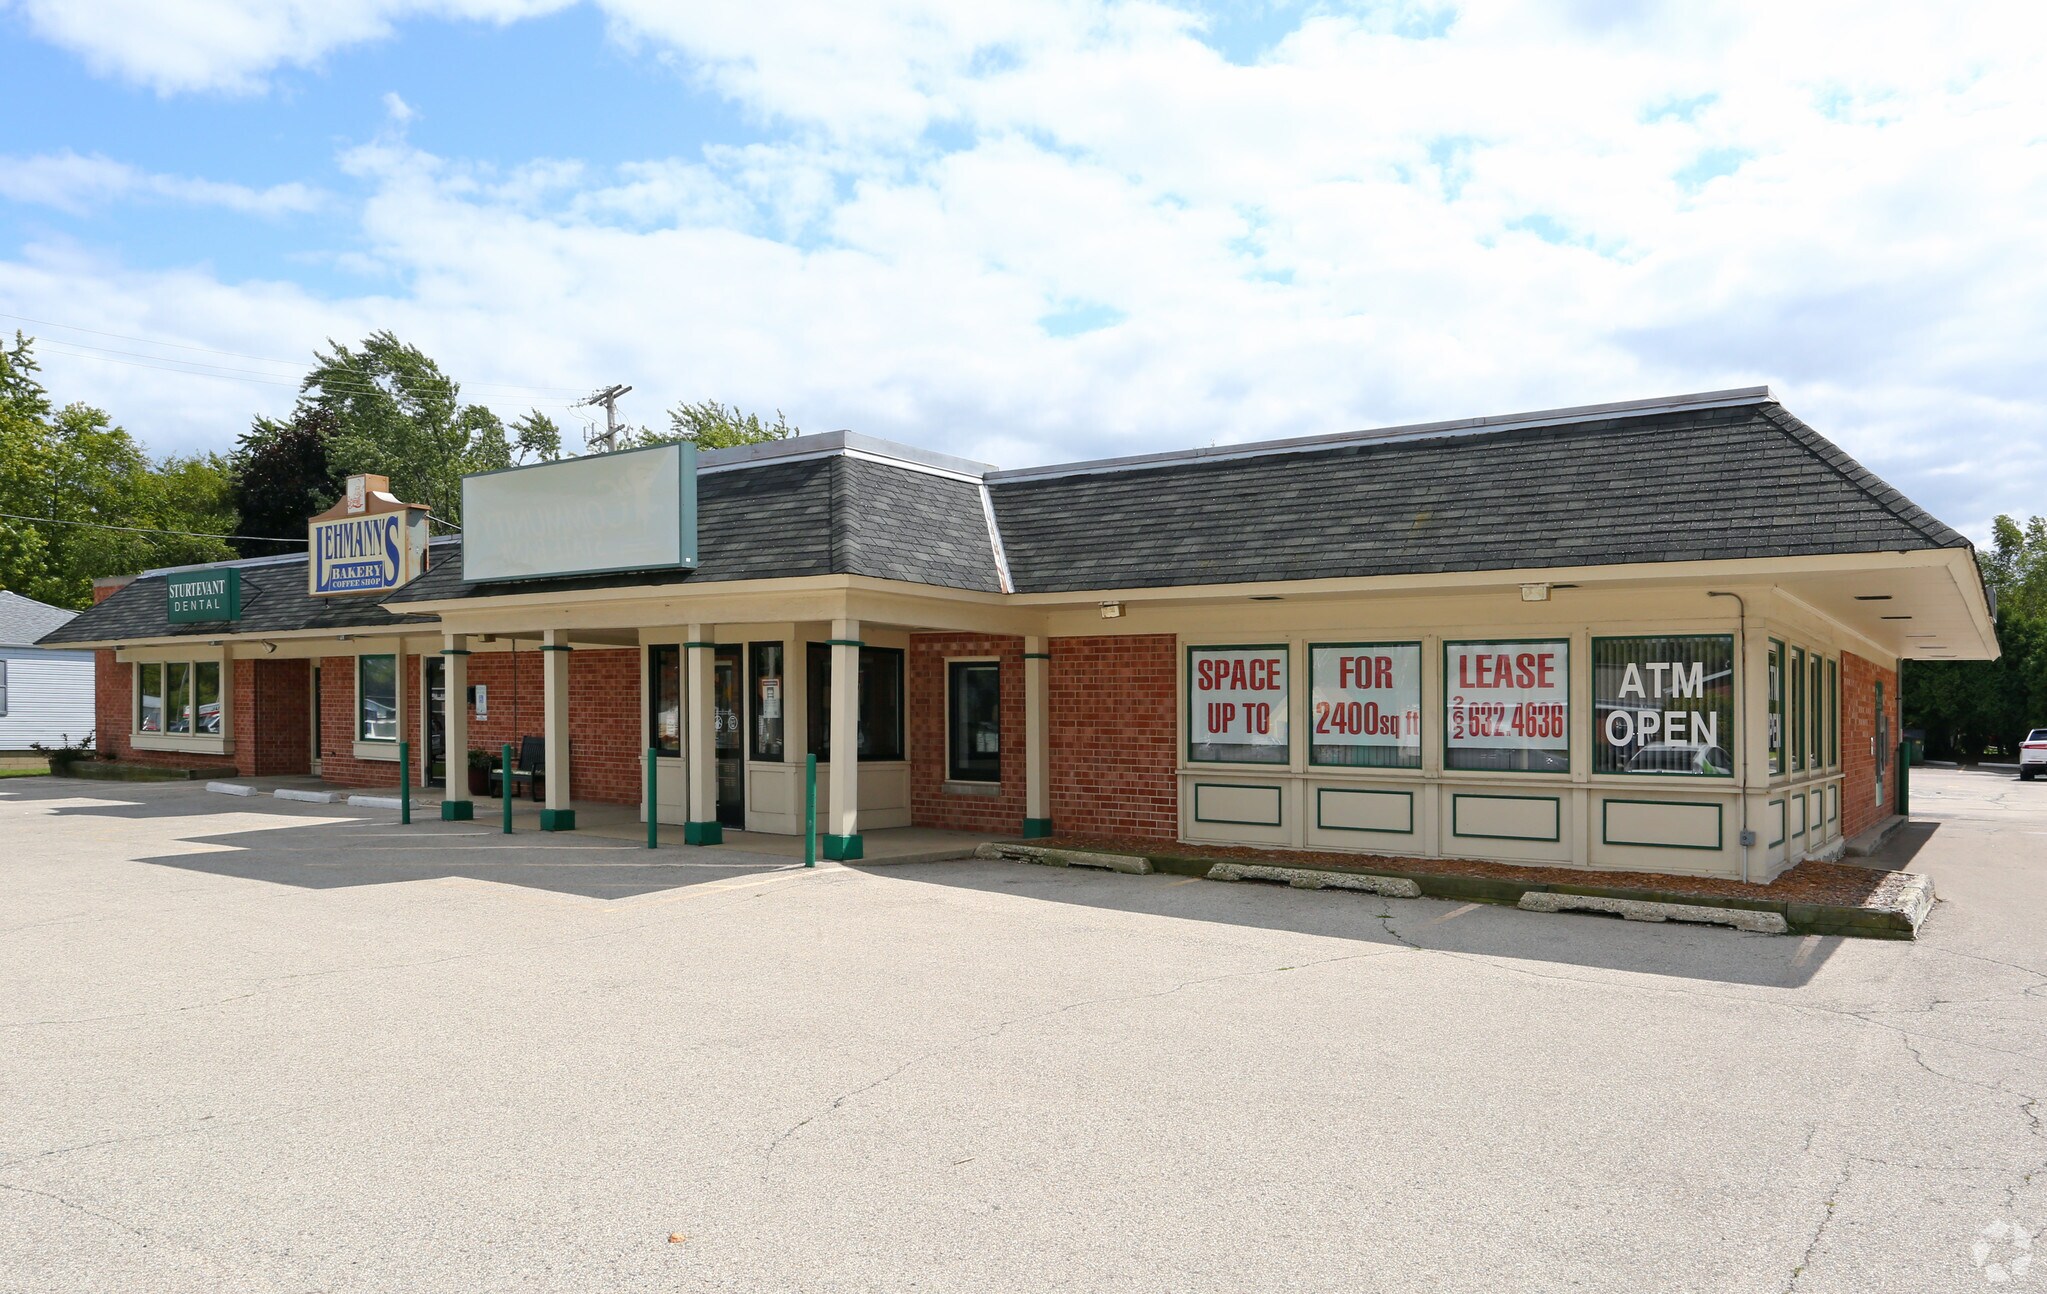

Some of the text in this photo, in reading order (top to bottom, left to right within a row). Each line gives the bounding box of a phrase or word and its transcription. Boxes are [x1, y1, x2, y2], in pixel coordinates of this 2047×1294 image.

[315, 515, 400, 593] LEHMANN'S
[169, 579, 225, 598] STURTEVANT
[332, 564, 382, 580] BAKERY
[332, 577, 381, 588] COFFEE SHOP
[174, 599, 220, 612] DENTAL
[1198, 658, 1281, 691] SPACE
[1339, 655, 1393, 690] FOR
[1459, 653, 1555, 689] LEASE
[1618, 661, 1704, 698] ATM
[1207, 702, 1270, 735] UP TO
[1405, 710, 1419, 736] ft
[1604, 710, 1718, 748] OPEN
